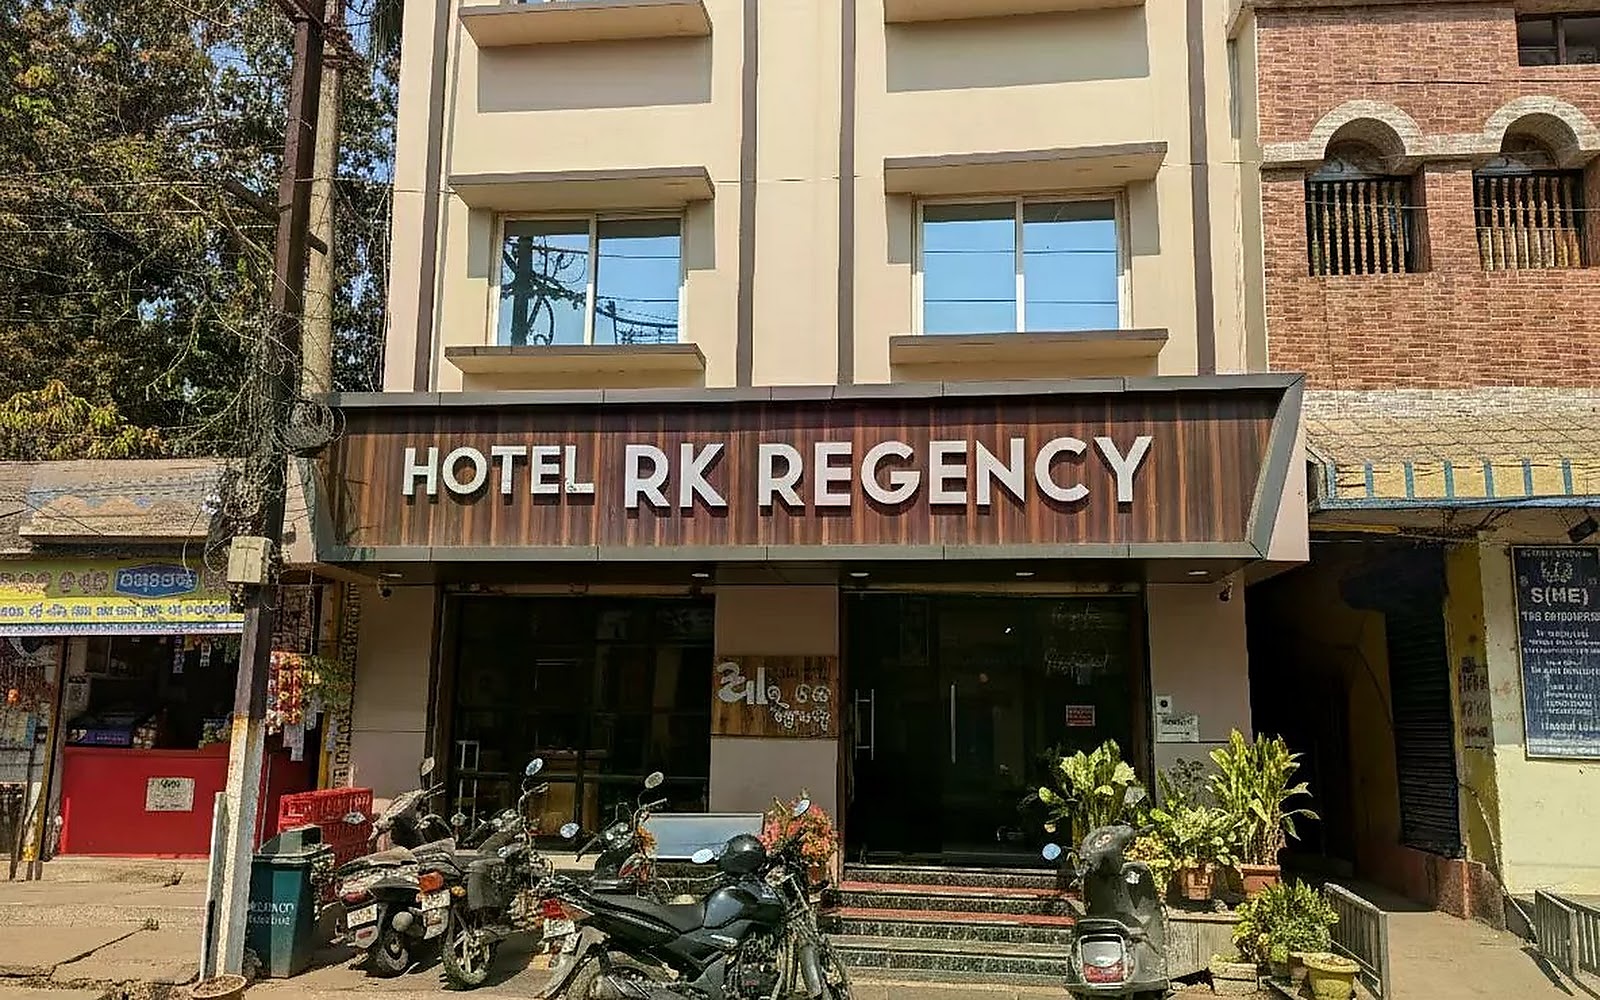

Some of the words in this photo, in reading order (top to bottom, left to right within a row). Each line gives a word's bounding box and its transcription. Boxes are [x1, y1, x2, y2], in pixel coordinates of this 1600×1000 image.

[402, 444, 595, 497] HOTEL
[624, 443, 728, 509] RK
[757, 435, 1153, 507] REGENCY
